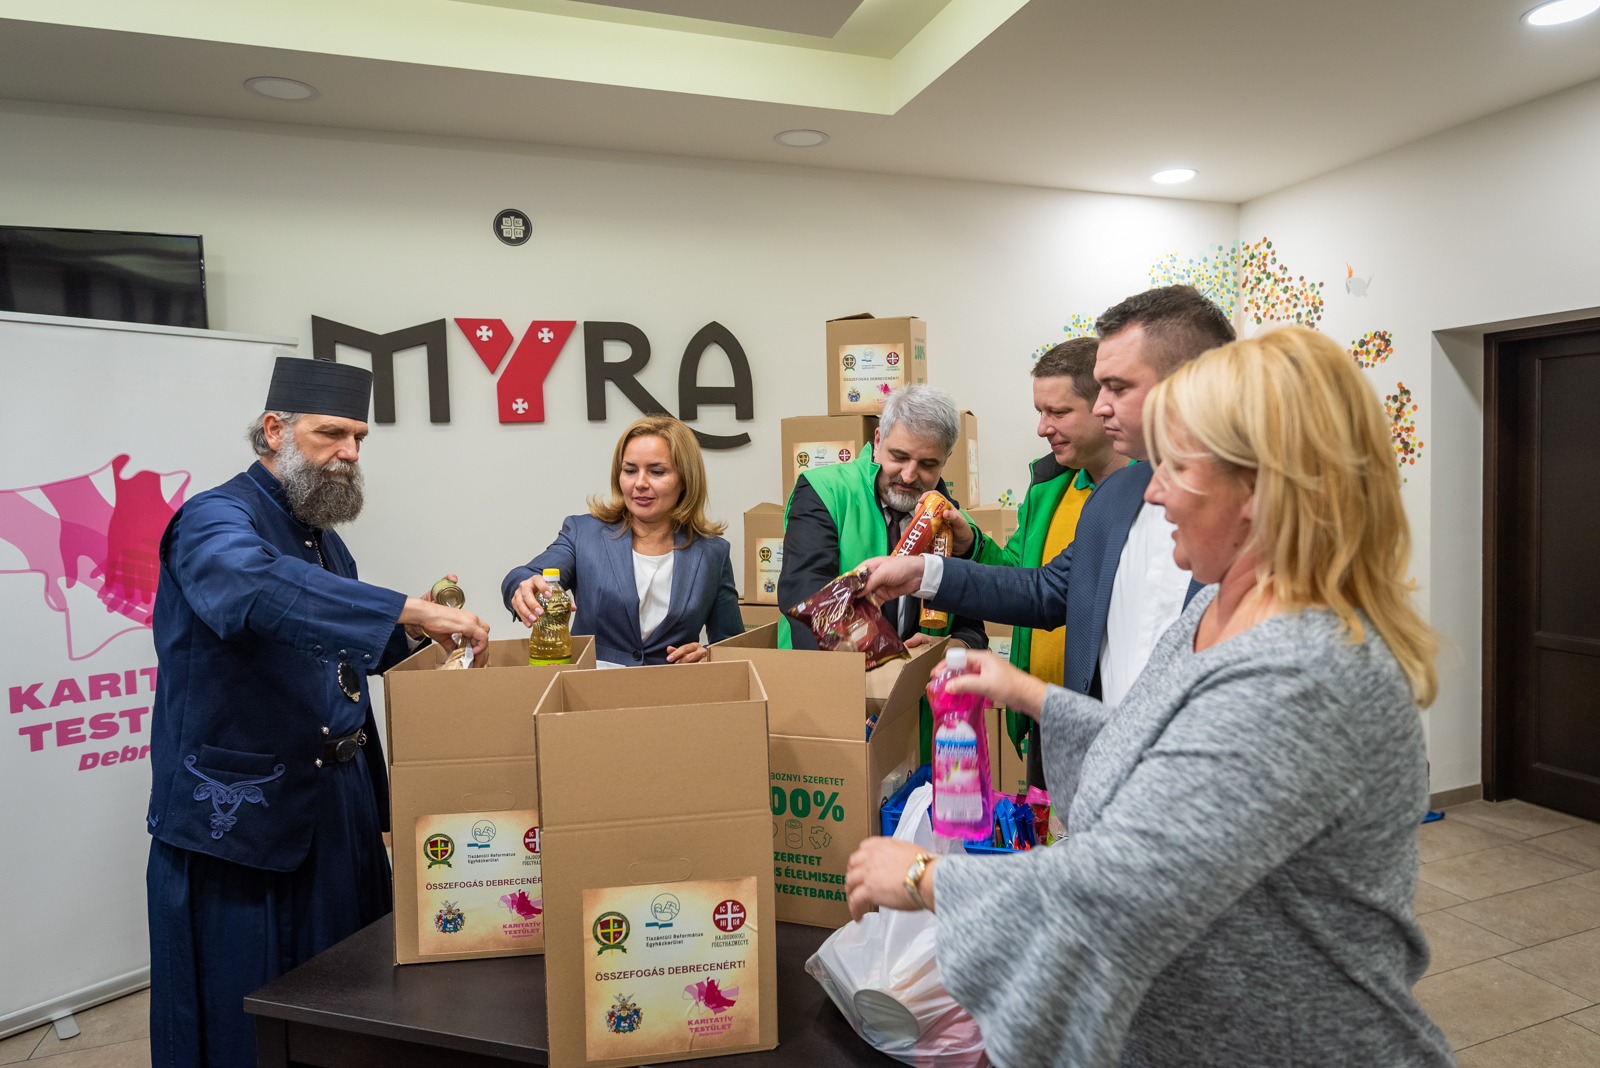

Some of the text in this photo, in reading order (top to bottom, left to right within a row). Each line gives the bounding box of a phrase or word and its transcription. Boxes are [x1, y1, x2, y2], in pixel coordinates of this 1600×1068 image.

[311, 313, 754, 450] MYRA
[9, 666, 158, 714] KARIT
[18, 705, 153, 752] TEST
[78, 744, 150, 772] Debr
[771, 772, 844, 786] BOZNYI SZERETET
[772, 786, 844, 822] 00%
[774, 851, 822, 866] ZERETET
[426, 876, 542, 890] ÖSSZEFOGÁS DEBRECENÉR
[775, 882, 847, 902] YEZETBARÁT
[595, 960, 746, 982] ÖSSZEFOGÁS DEBRECENÉRT!
[688, 1015, 734, 1026] KARITATÍV
[689, 1023, 732, 1034] TESTÜLET
